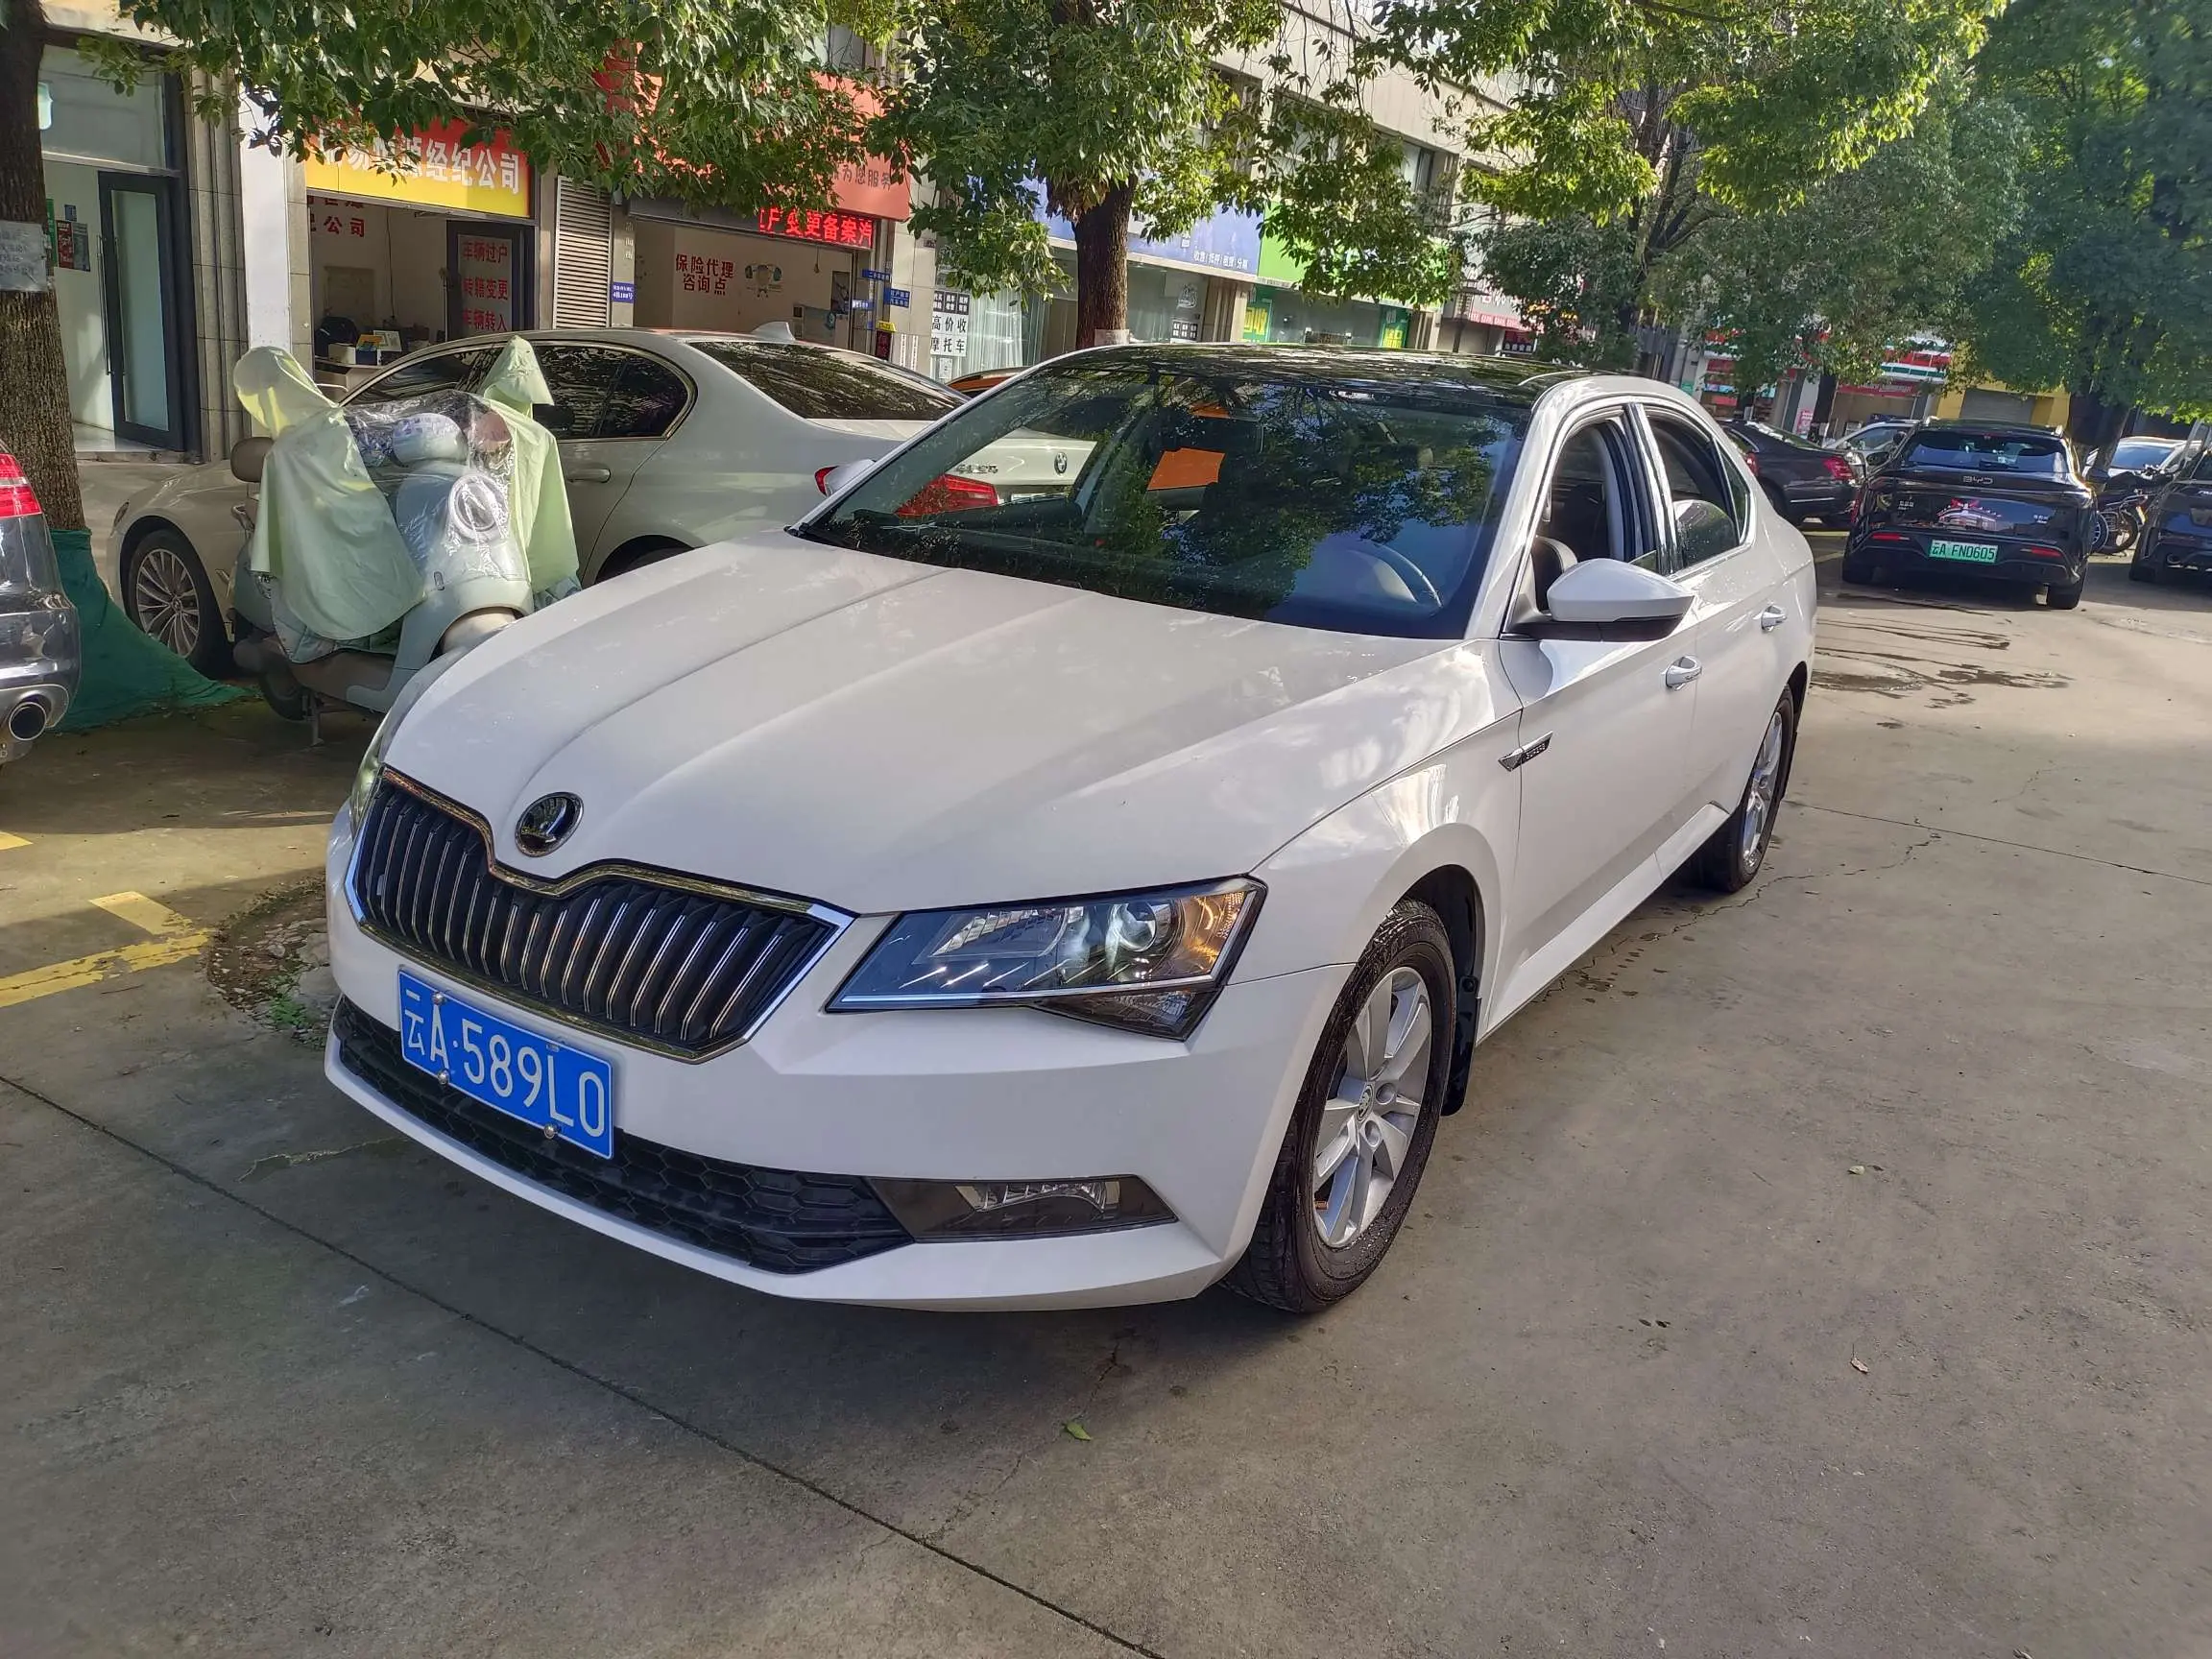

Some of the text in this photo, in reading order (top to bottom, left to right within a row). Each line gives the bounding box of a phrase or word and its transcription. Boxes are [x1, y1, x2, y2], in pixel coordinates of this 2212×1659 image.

[676, 253, 733, 278] 保险代理
[684, 274, 726, 296] 咨询点
[931, 315, 967, 333] 高价收
[931, 337, 965, 353] 摩托车
[1962, 475, 1993, 484] BYD
